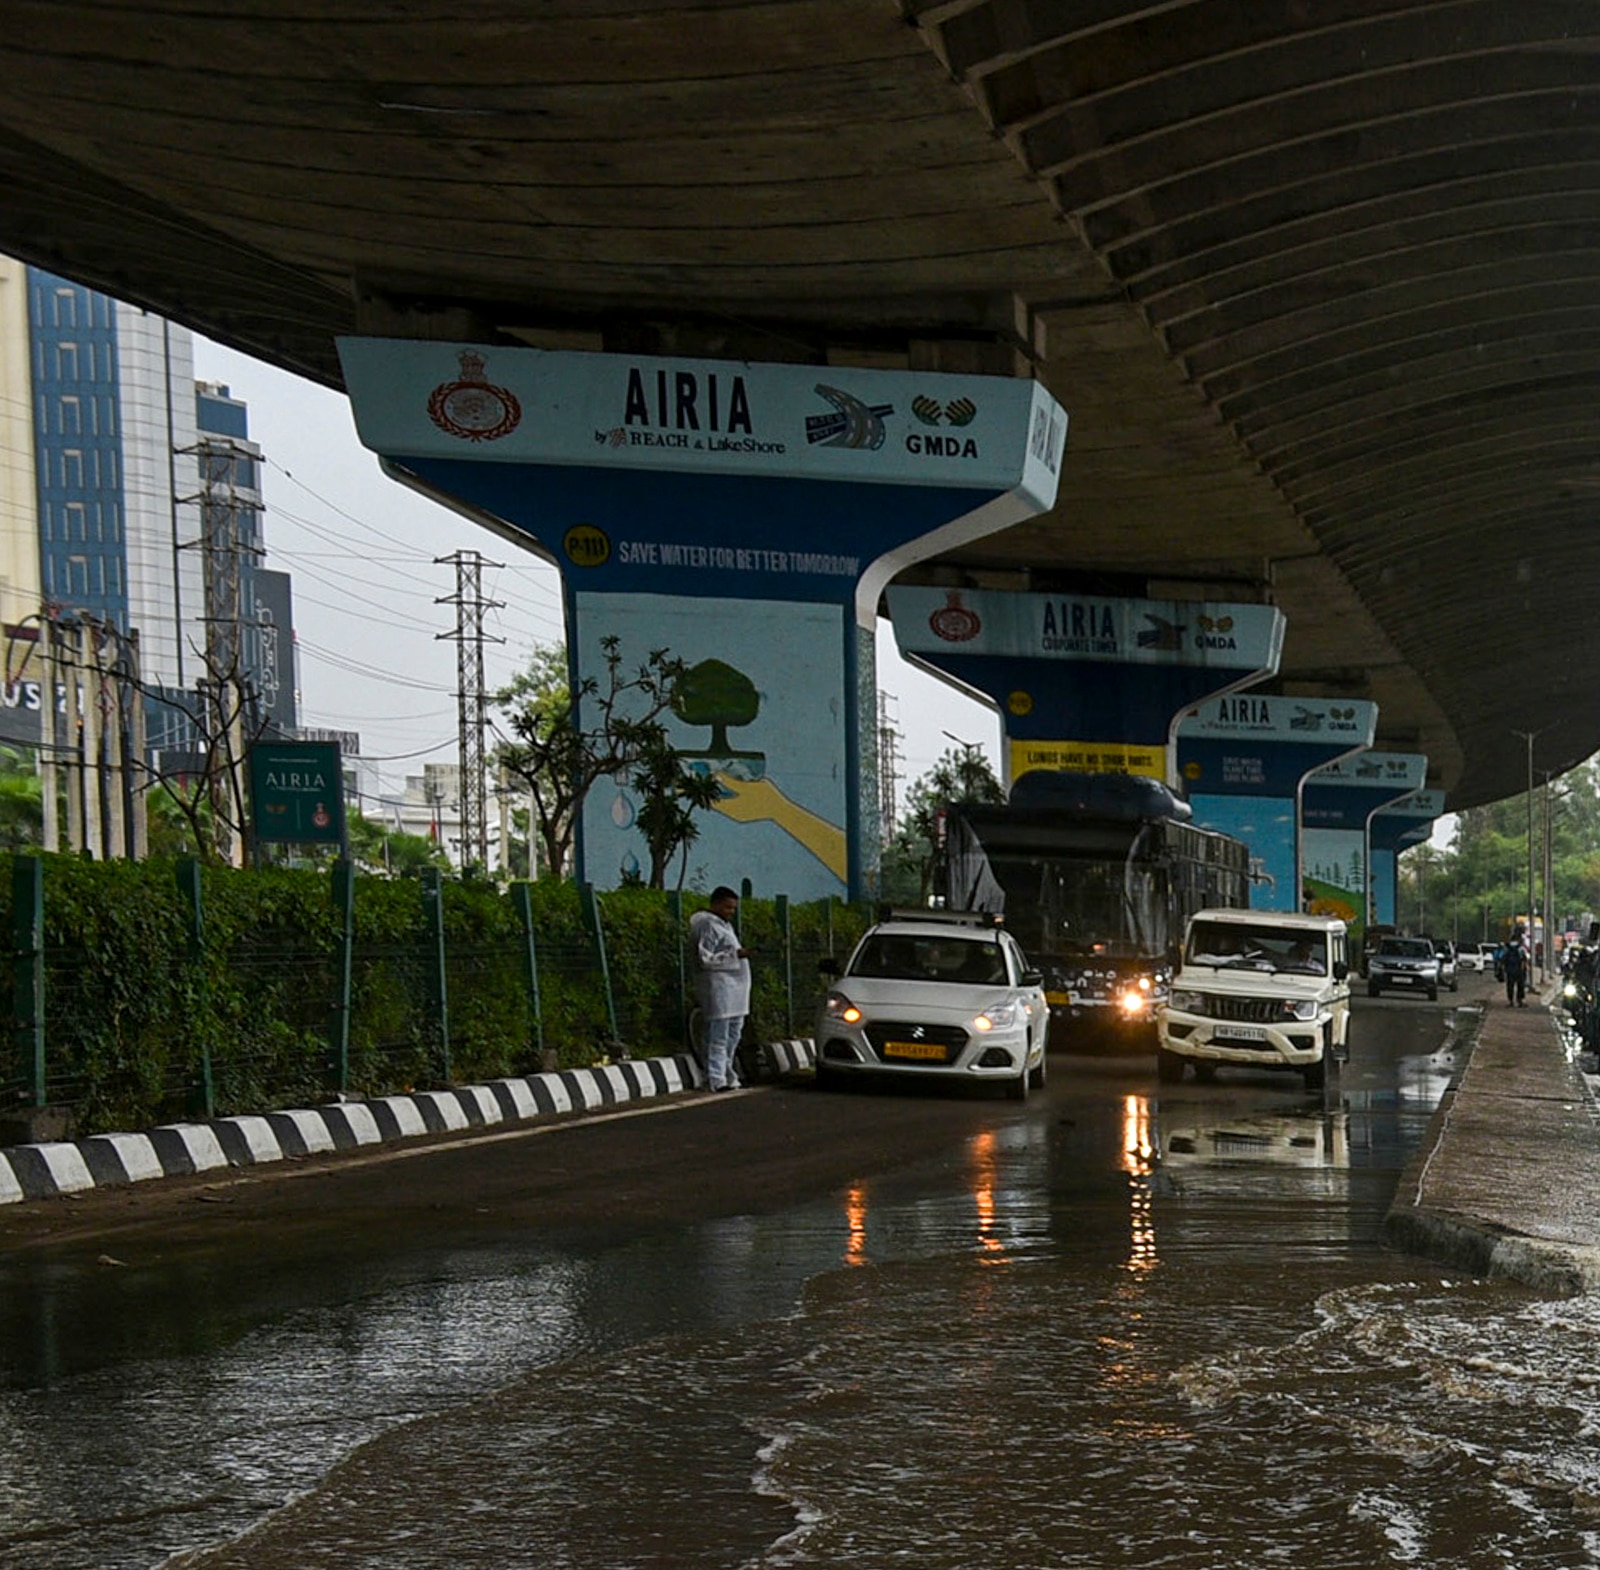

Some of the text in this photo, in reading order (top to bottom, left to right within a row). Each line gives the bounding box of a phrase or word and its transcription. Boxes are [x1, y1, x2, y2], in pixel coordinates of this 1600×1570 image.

[624, 367, 753, 435] AIRIA
[595, 429, 607, 446] by
[630, 431, 689, 449] REACH
[708, 436, 786, 454] LakeShore
[905, 434, 978, 459] GMDA
[569, 537, 605, 556] P-111
[619, 540, 860, 577] SAVE WATER FOR BETTER TOMORROW
[1043, 601, 1115, 638] AIRIA
[1195, 635, 1237, 651] GMDA
[1219, 698, 1270, 724] AIRIA
[265, 772, 325, 787] AIRIA
